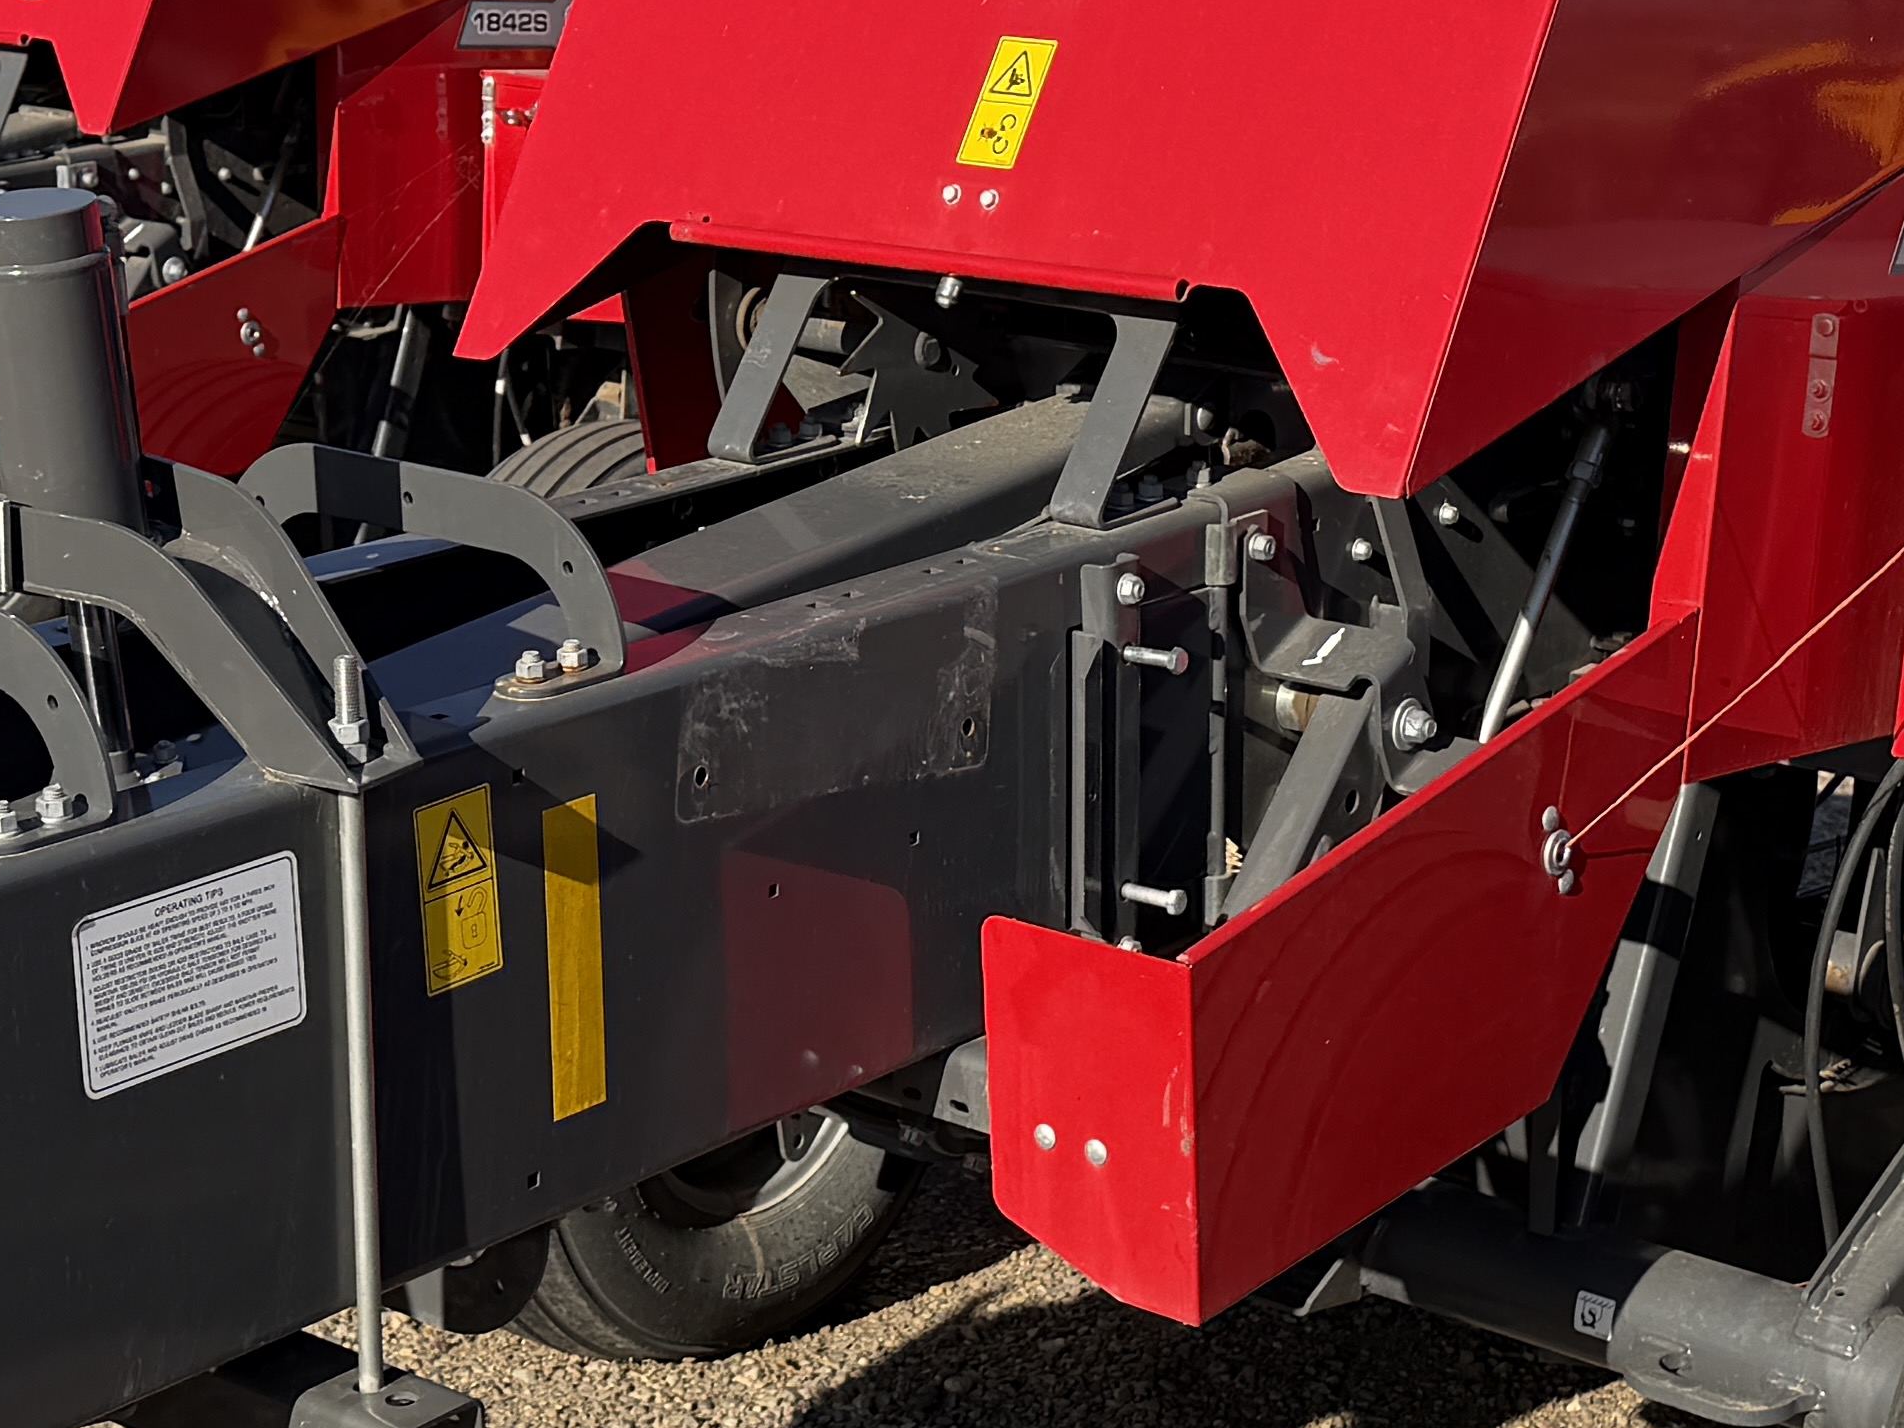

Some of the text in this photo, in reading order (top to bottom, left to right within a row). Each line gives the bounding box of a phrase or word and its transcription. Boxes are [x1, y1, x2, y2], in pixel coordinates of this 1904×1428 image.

[472, 10, 550, 34] 1842S
[153, 886, 223, 918] OPERATING TIPS
[722, 1202, 875, 1299] CARLSTAR
